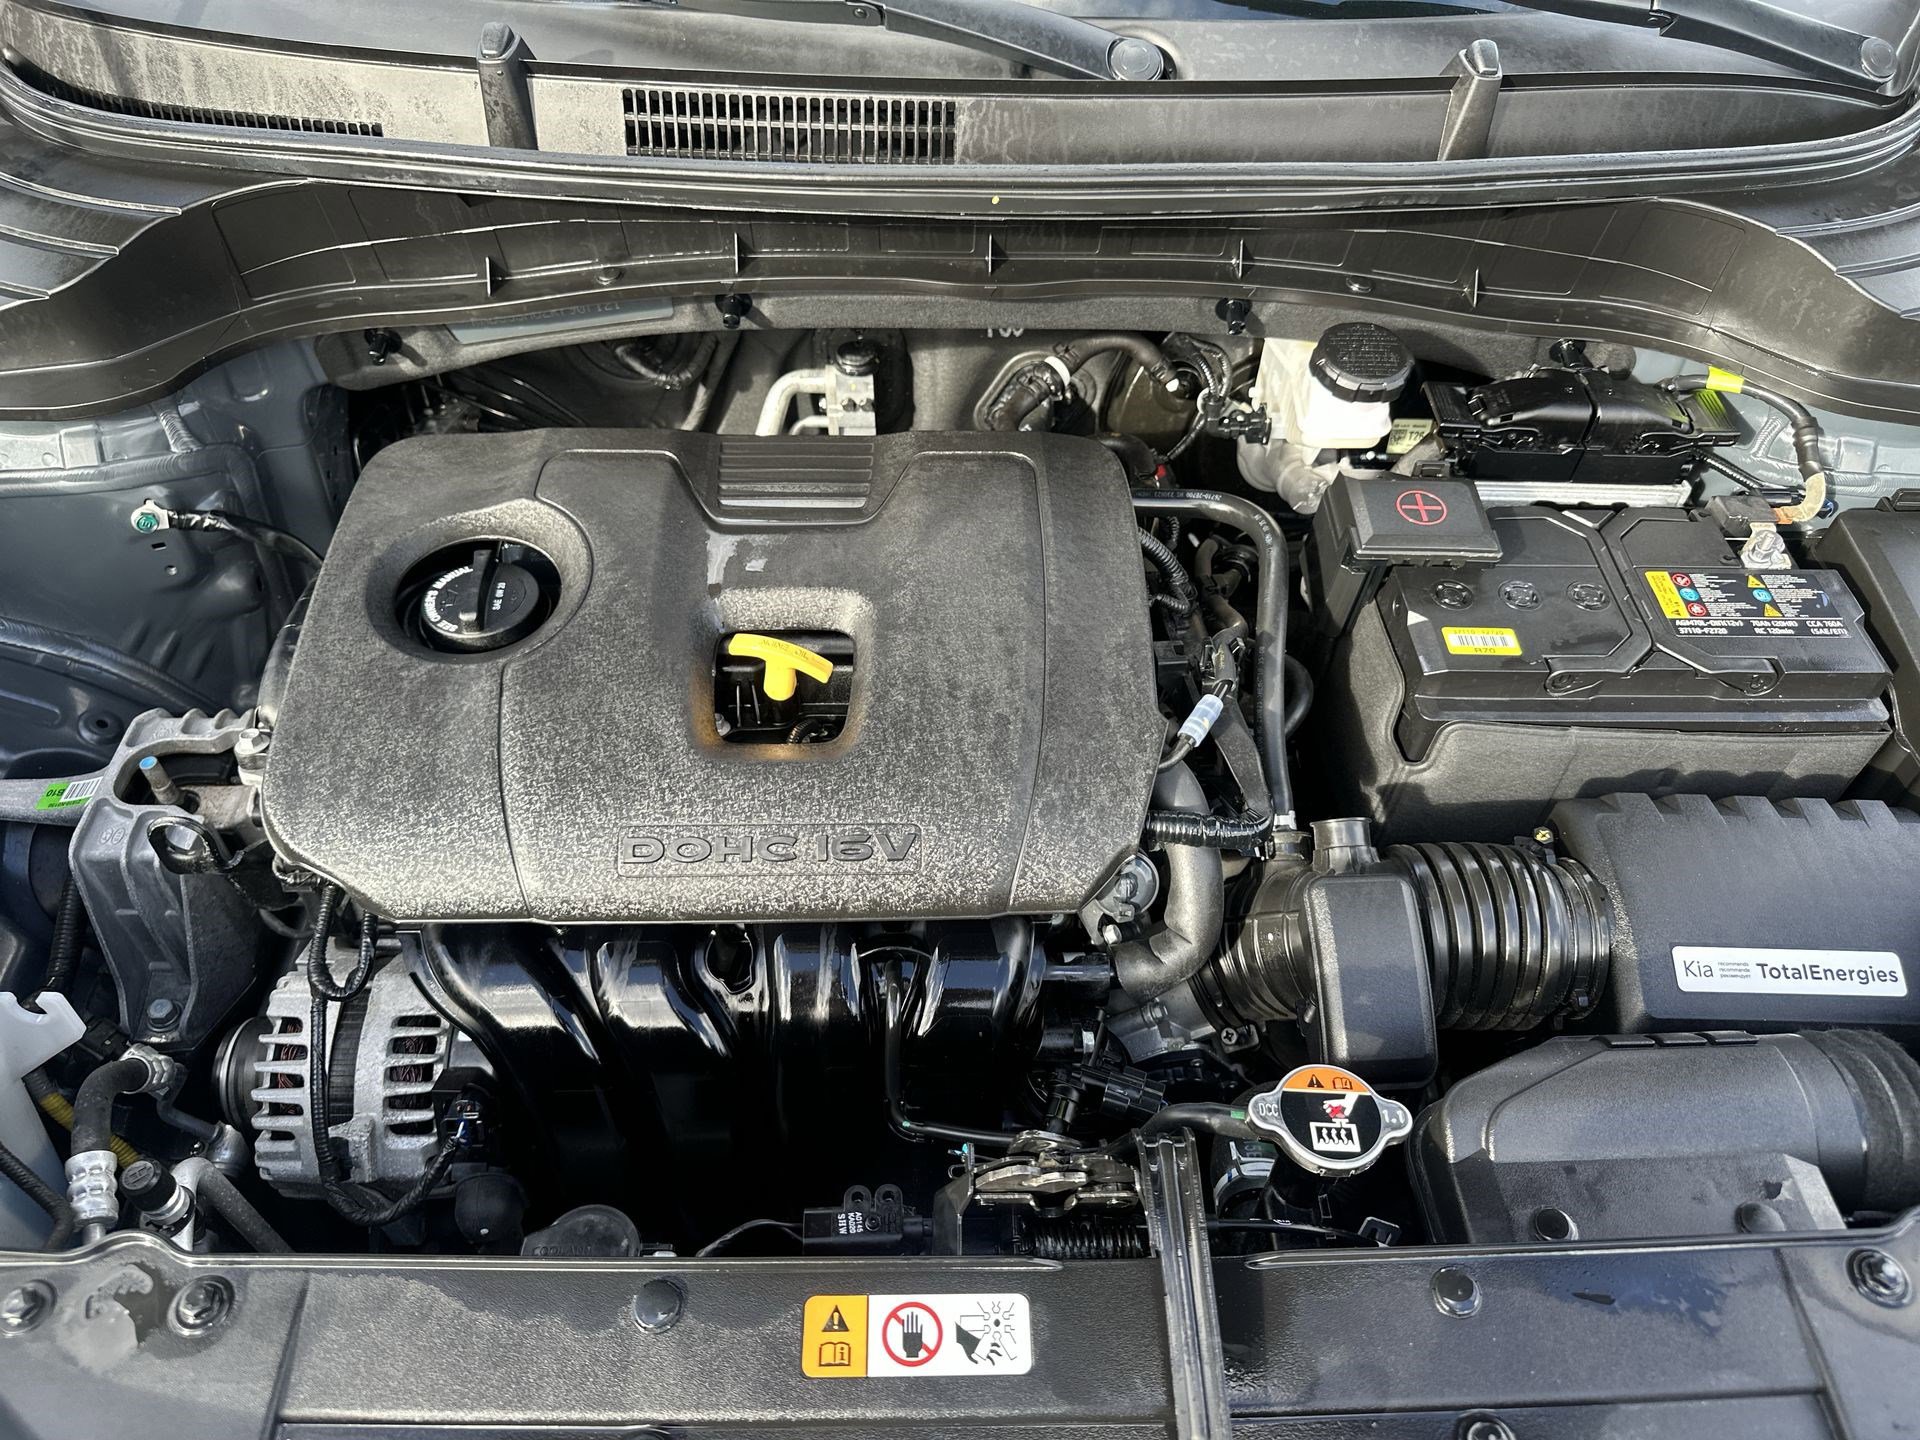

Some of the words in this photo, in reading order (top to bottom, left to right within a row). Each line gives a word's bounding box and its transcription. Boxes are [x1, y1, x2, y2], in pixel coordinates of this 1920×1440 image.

[432, 565, 474, 590] MANUAL
[436, 619, 459, 633] SEE
[1754, 627, 1767, 635] RC
[1805, 619, 1823, 627] CCA
[622, 834, 798, 864] DOHC
[817, 833, 920, 863] 16V
[1682, 959, 1714, 979] Kia
[1755, 962, 1899, 985] TotalEnergies
[1381, 1109, 1405, 1124] 1.1
[838, 1213, 848, 1235] SHW
